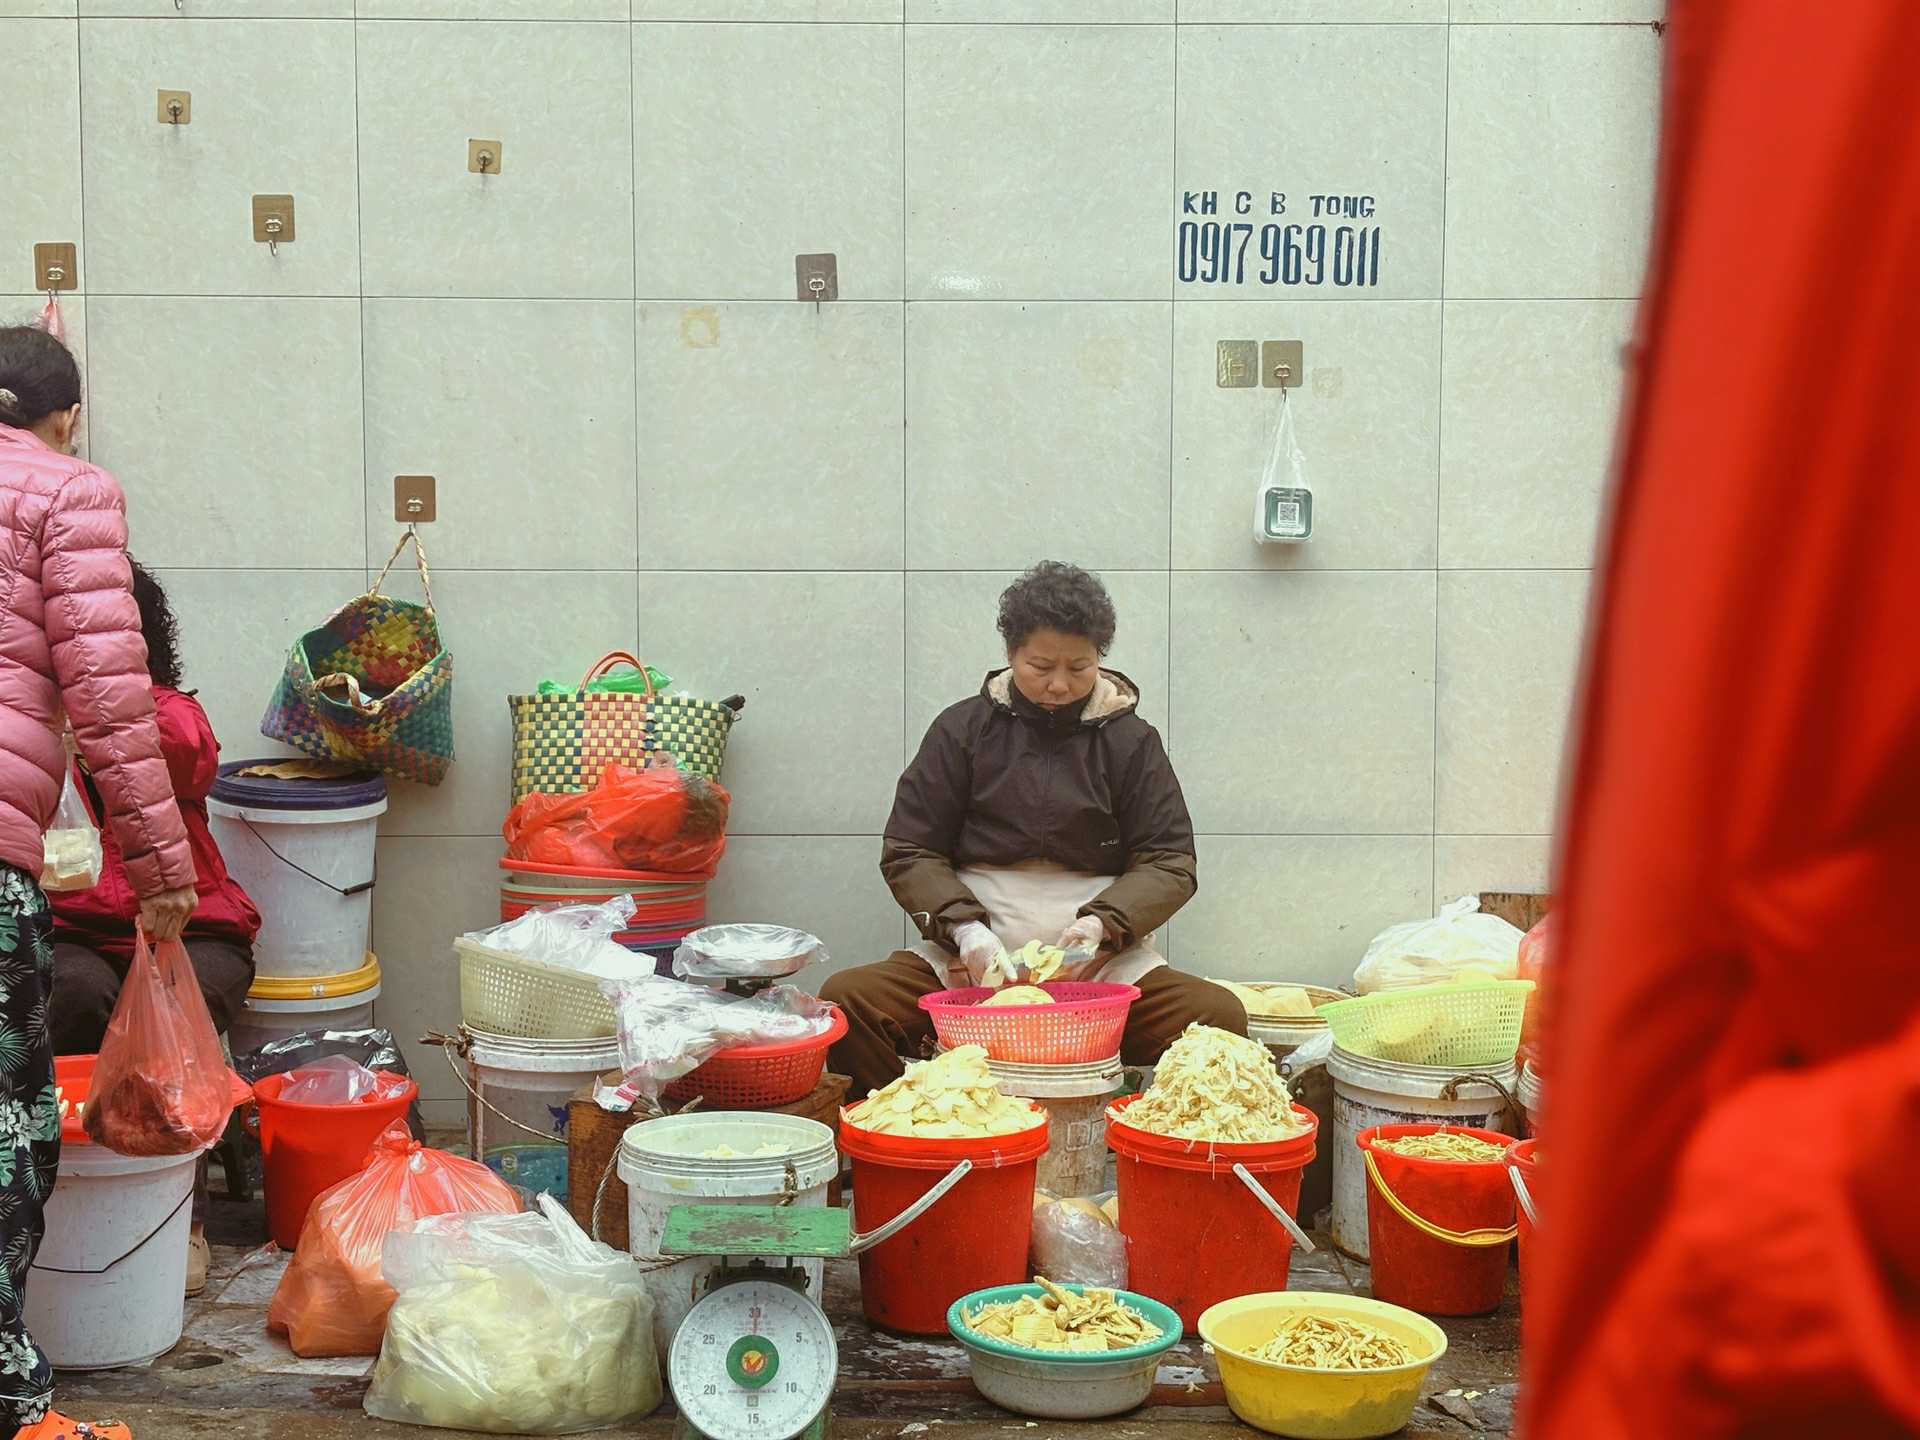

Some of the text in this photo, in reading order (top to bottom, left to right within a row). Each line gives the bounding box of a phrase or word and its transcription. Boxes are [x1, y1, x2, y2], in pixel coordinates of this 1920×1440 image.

[1183, 191, 1375, 218] KH C B TONG
[1179, 221, 1380, 286] 0917 969 011
[702, 1334, 716, 1345] 25
[795, 1332, 803, 1343] 5
[703, 1384, 717, 1395] 20
[785, 1382, 797, 1392] 10
[747, 1413, 760, 1424] 15
